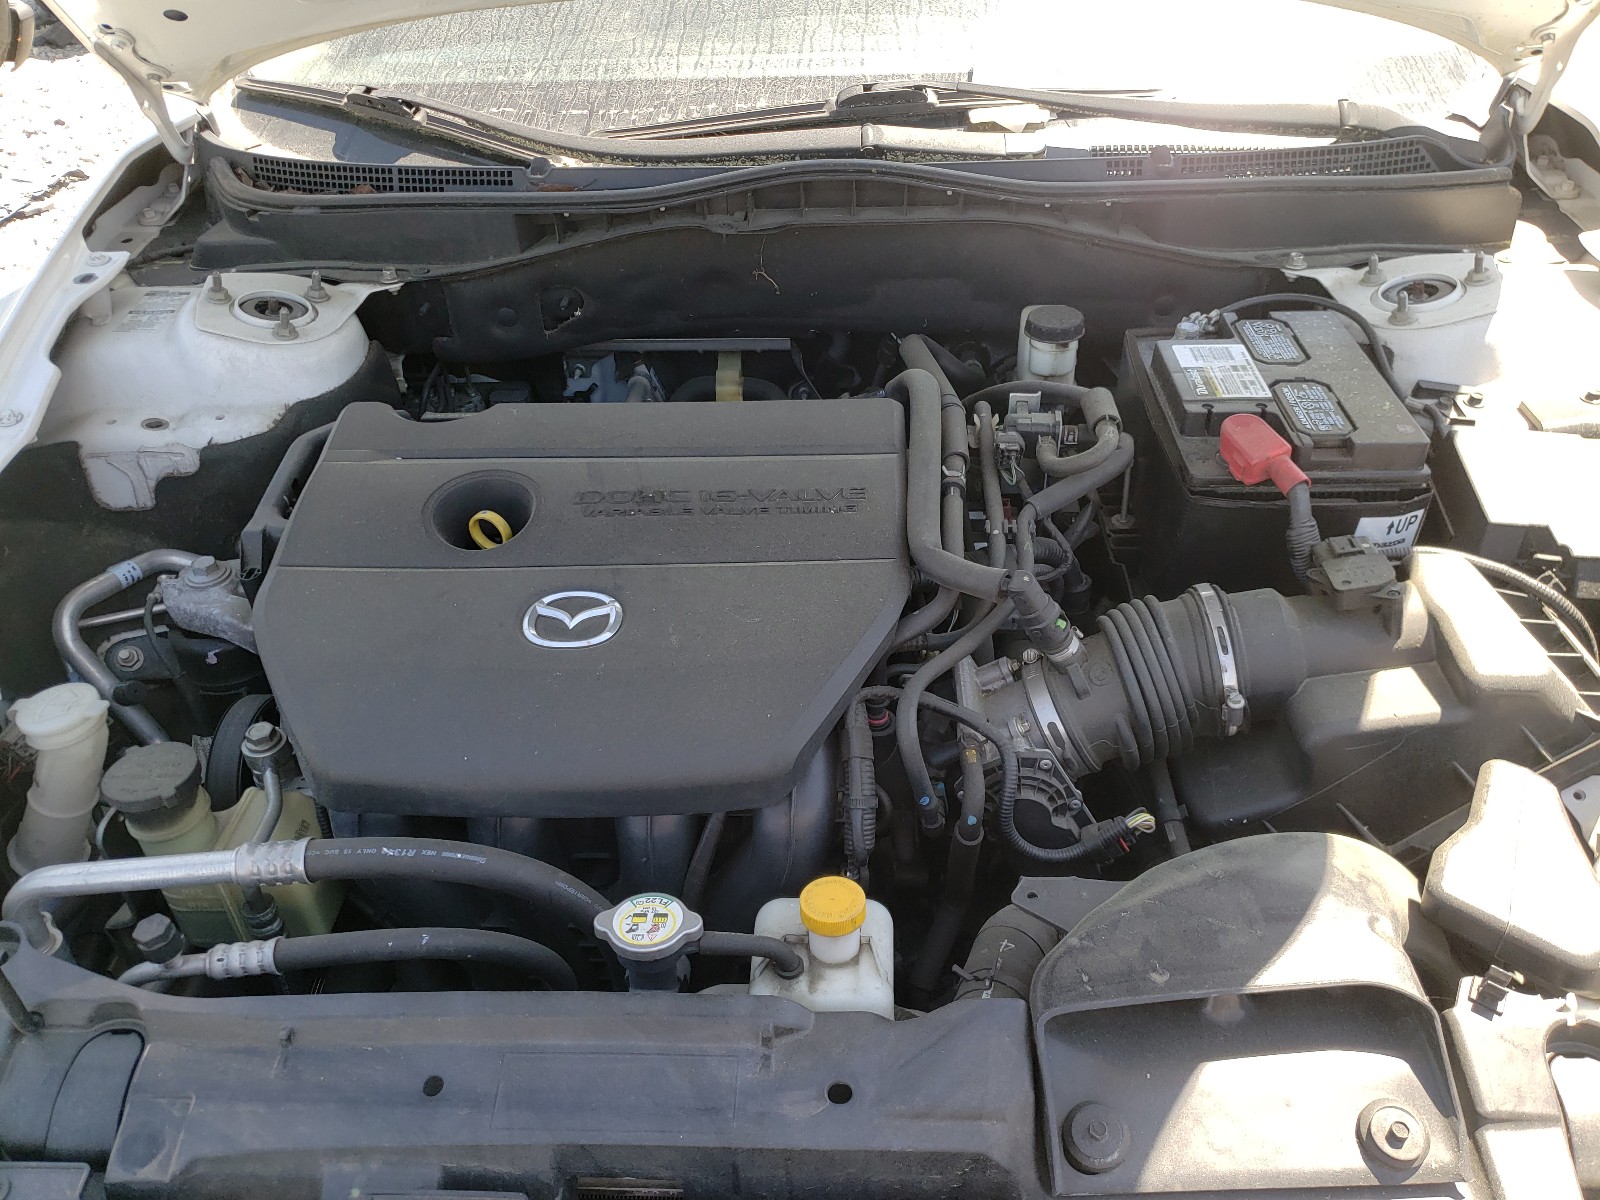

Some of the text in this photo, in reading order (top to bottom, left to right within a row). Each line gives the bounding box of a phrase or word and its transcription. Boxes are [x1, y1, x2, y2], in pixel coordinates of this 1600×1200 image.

[1186, 368, 1209, 397] Duralast
[573, 486, 868, 506] DOHC 16-VALVE
[699, 505, 770, 517] VALVE
[1395, 514, 1419, 534] UP
[355, 847, 378, 855] ONLY
[645, 898, 669, 906] FL22
